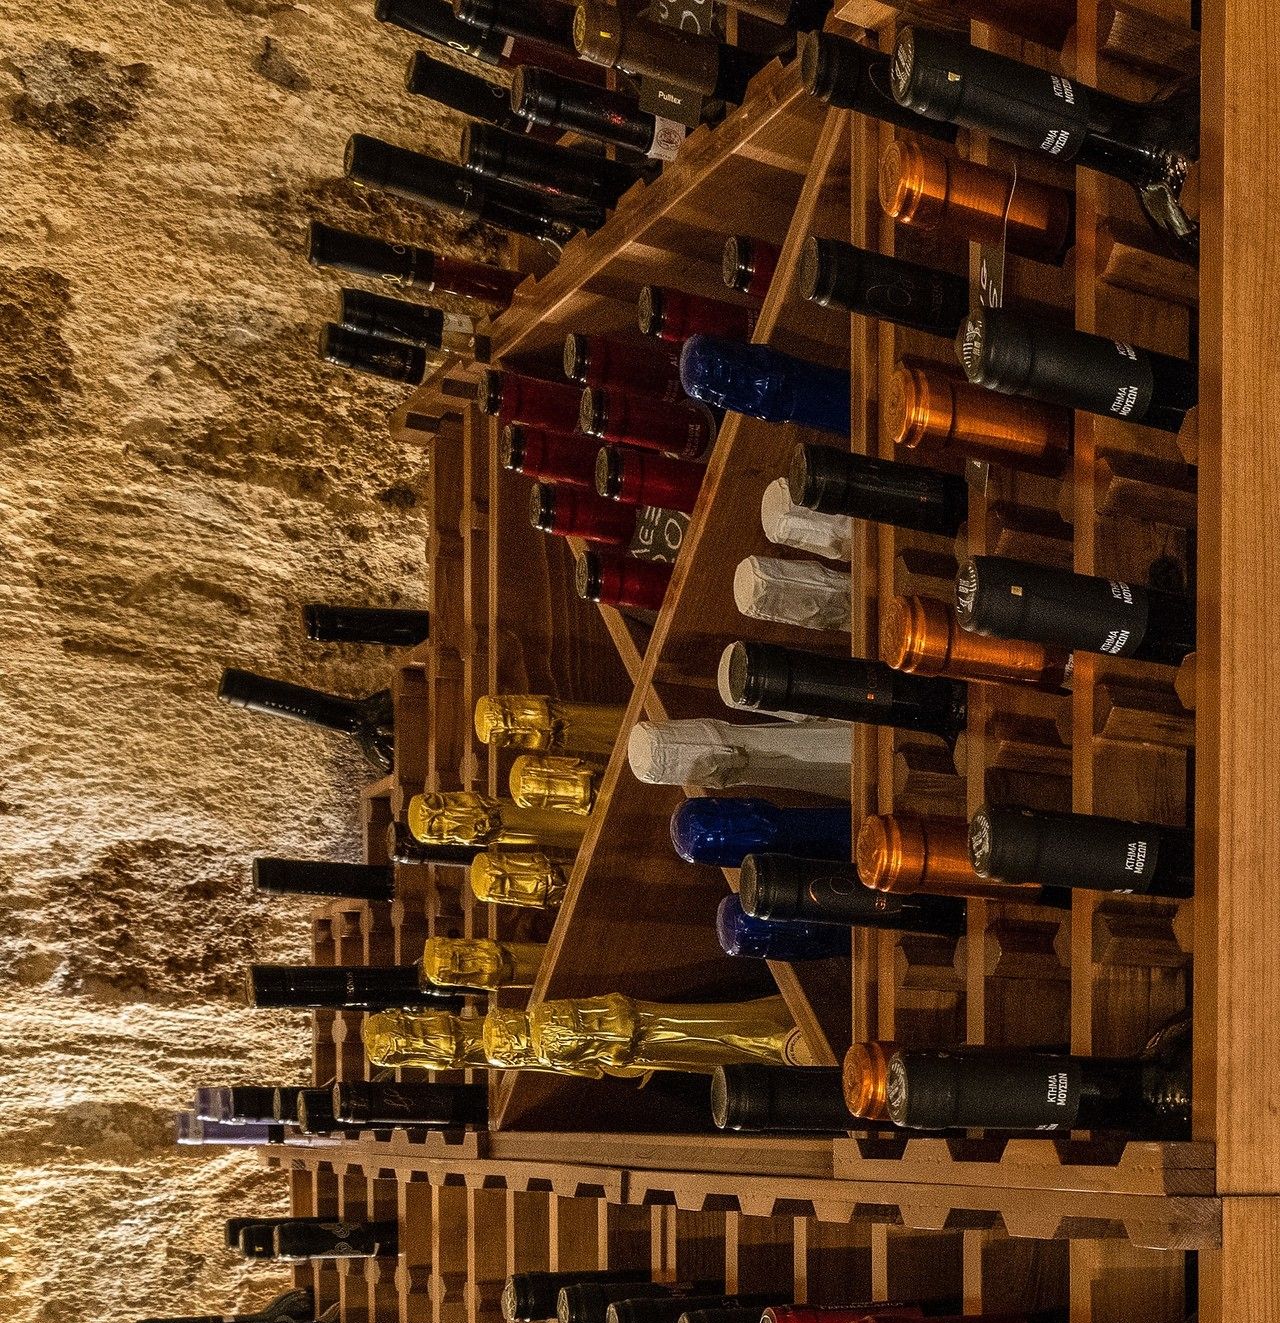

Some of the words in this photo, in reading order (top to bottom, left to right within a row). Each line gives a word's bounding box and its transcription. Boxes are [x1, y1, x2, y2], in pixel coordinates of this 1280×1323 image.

[658, 90, 682, 105] Pulltex
[1040, 129, 1059, 151] ΚΤΗΜΑ
[1110, 387, 1128, 412] ΚΤΗΜΑ
[1119, 386, 1138, 416] ΜΟΥΣΩΝ
[1100, 631, 1119, 652] ΚΤΗΜΑ
[1107, 630, 1131, 654] ΜΟΥΣΩΝ
[1125, 843, 1137, 870] ΚΤΗΜΑ
[1132, 842, 1147, 874] ΜΟΥΣΩΝ
[1047, 1075, 1058, 1102] ΚΤΗΜΑ
[1056, 1073, 1068, 1105] ΜΟΥΣΩΝ
